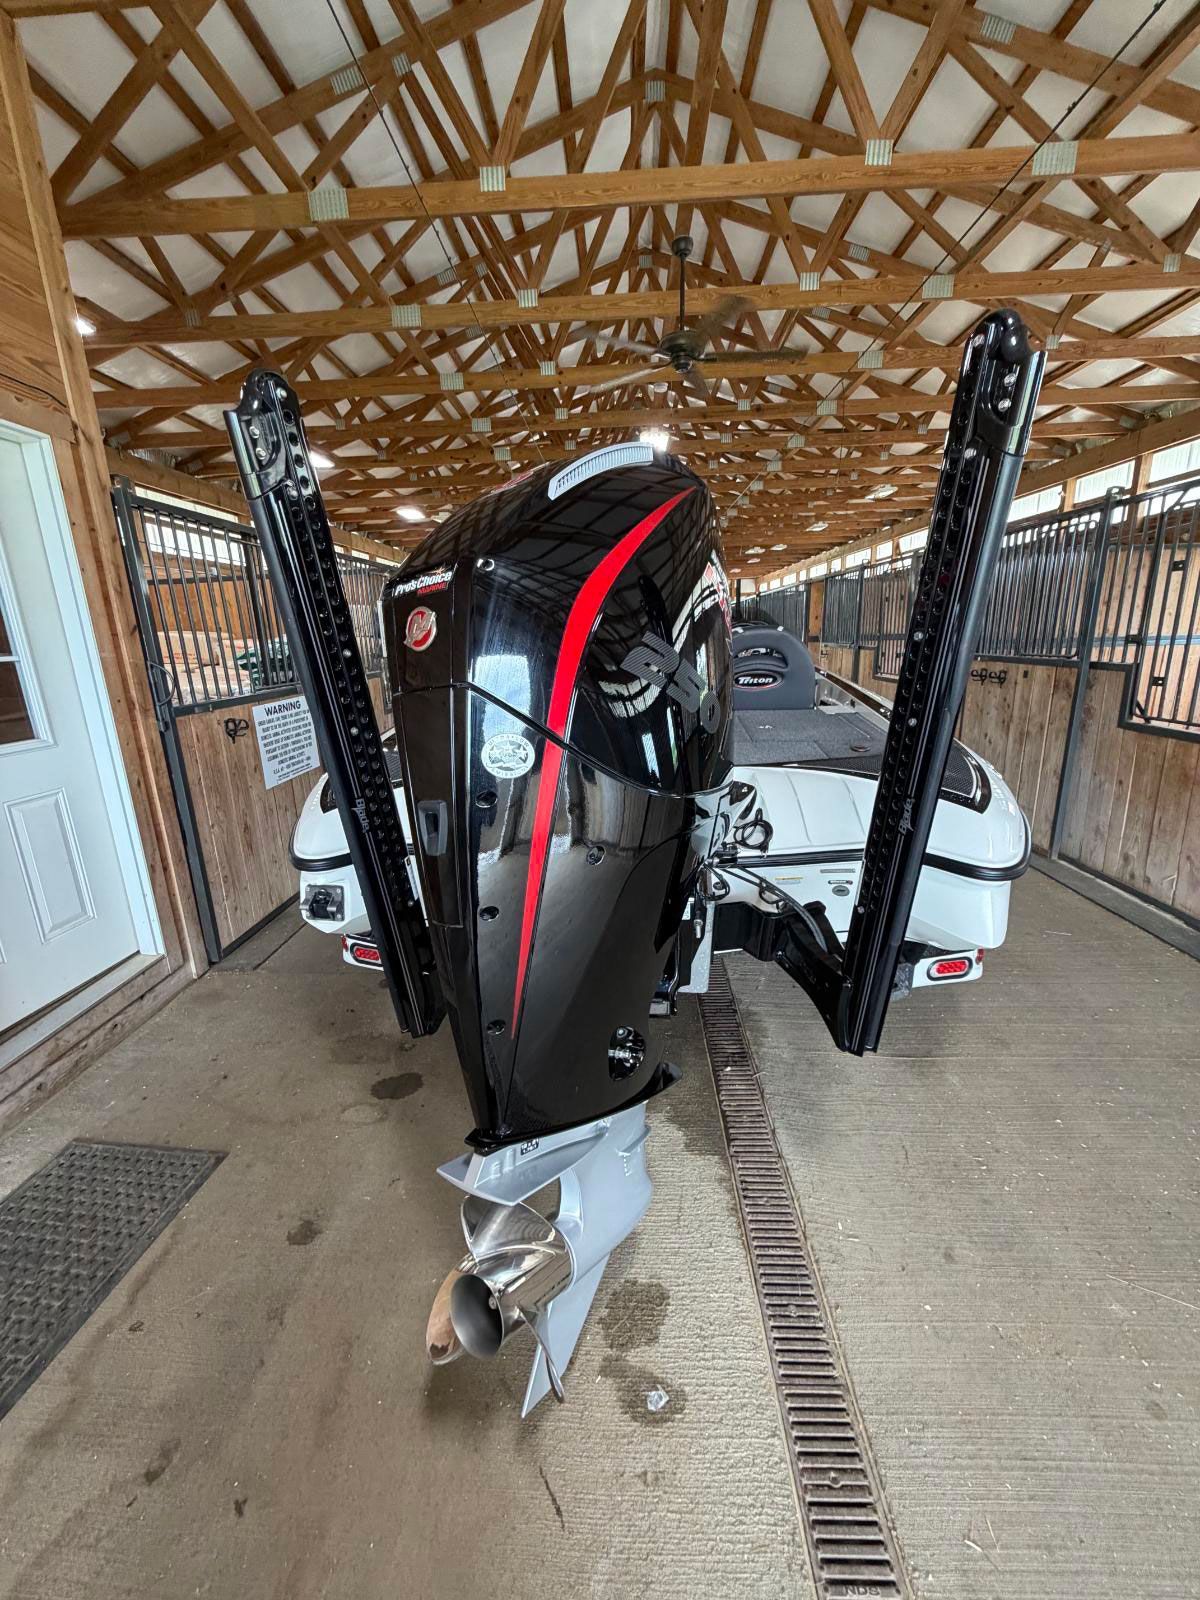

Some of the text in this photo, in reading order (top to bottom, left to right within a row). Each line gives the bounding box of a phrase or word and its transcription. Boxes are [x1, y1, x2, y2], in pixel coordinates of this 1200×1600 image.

[620, 630, 720, 734] 250
[264, 700, 301, 717] WARNING
[351, 798, 369, 832] Blade
[898, 798, 914, 836] Blade
[843, 1585, 880, 1595] NDS
